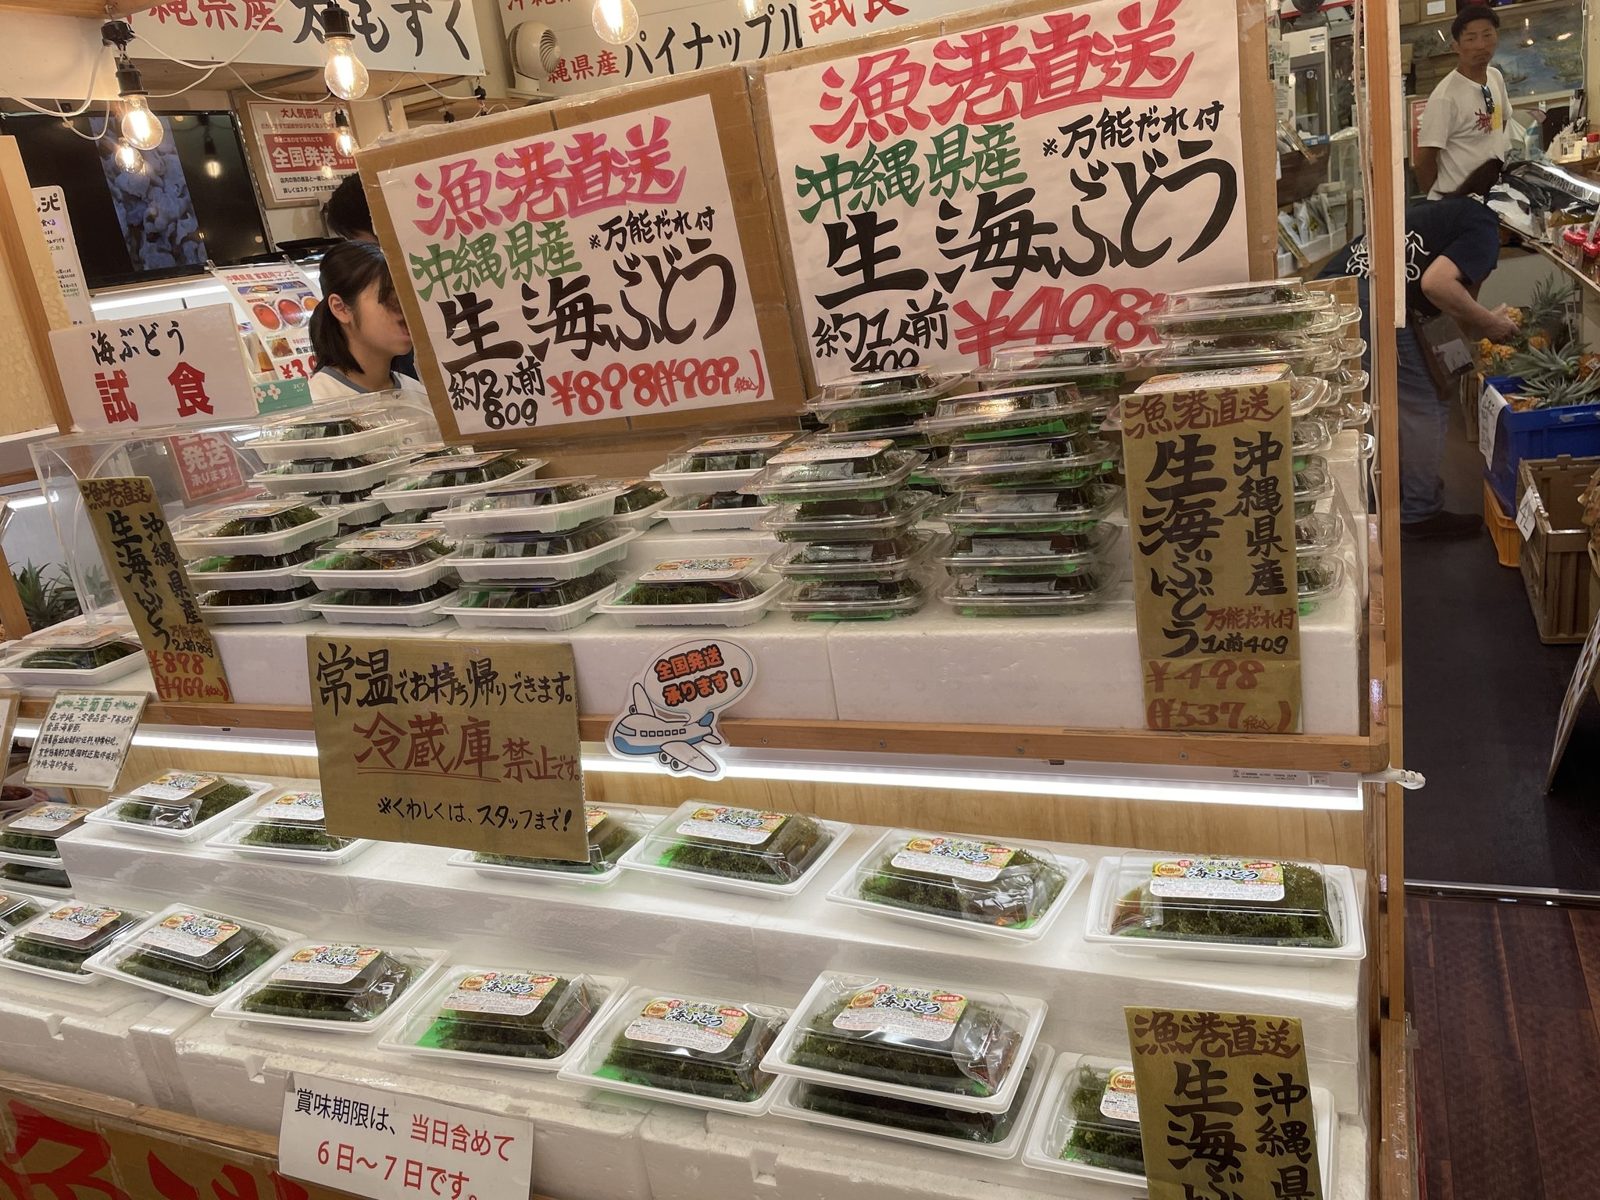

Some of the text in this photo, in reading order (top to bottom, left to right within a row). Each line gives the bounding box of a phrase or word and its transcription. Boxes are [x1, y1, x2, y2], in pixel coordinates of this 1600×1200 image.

[624, 3, 804, 78] パイナップル
[810, 0, 1194, 148] 漁港直送
[272, 145, 337, 168] 全国発送
[412, 116, 686, 239] 漁港直送
[796, 121, 1028, 223] 沖縄県産
[37, 193, 61, 213] シピ
[815, 139, 1238, 310] 生海ぶどう
[409, 220, 582, 301] 沖縄県産
[438, 238, 737, 371] 生海ぶどう
[91, 320, 185, 366] 海ぶどう
[449, 356, 546, 411] 約2人前
[1124, 386, 1284, 439] 漁港直送
[81, 479, 151, 510] 漁港直送
[1224, 431, 1288, 597] 沖縄県産
[106, 509, 171, 650] 生海ぶどう
[139, 511, 203, 625] 沖縄県産
[1138, 434, 1227, 658] 生海ぶどう
[1204, 605, 1297, 631] 万能だれ付
[148, 650, 205, 675] ¥898
[317, 643, 573, 717] 常温でお持ち帰りできます。
[654, 644, 724, 682] 全国発送
[662, 667, 743, 706] 承ります!
[1146, 658, 1265, 692] ¥498
[1135, 1011, 1300, 1059] 漁港直送
[295, 1088, 515, 1162] 賞味期限は、 当日含めて
